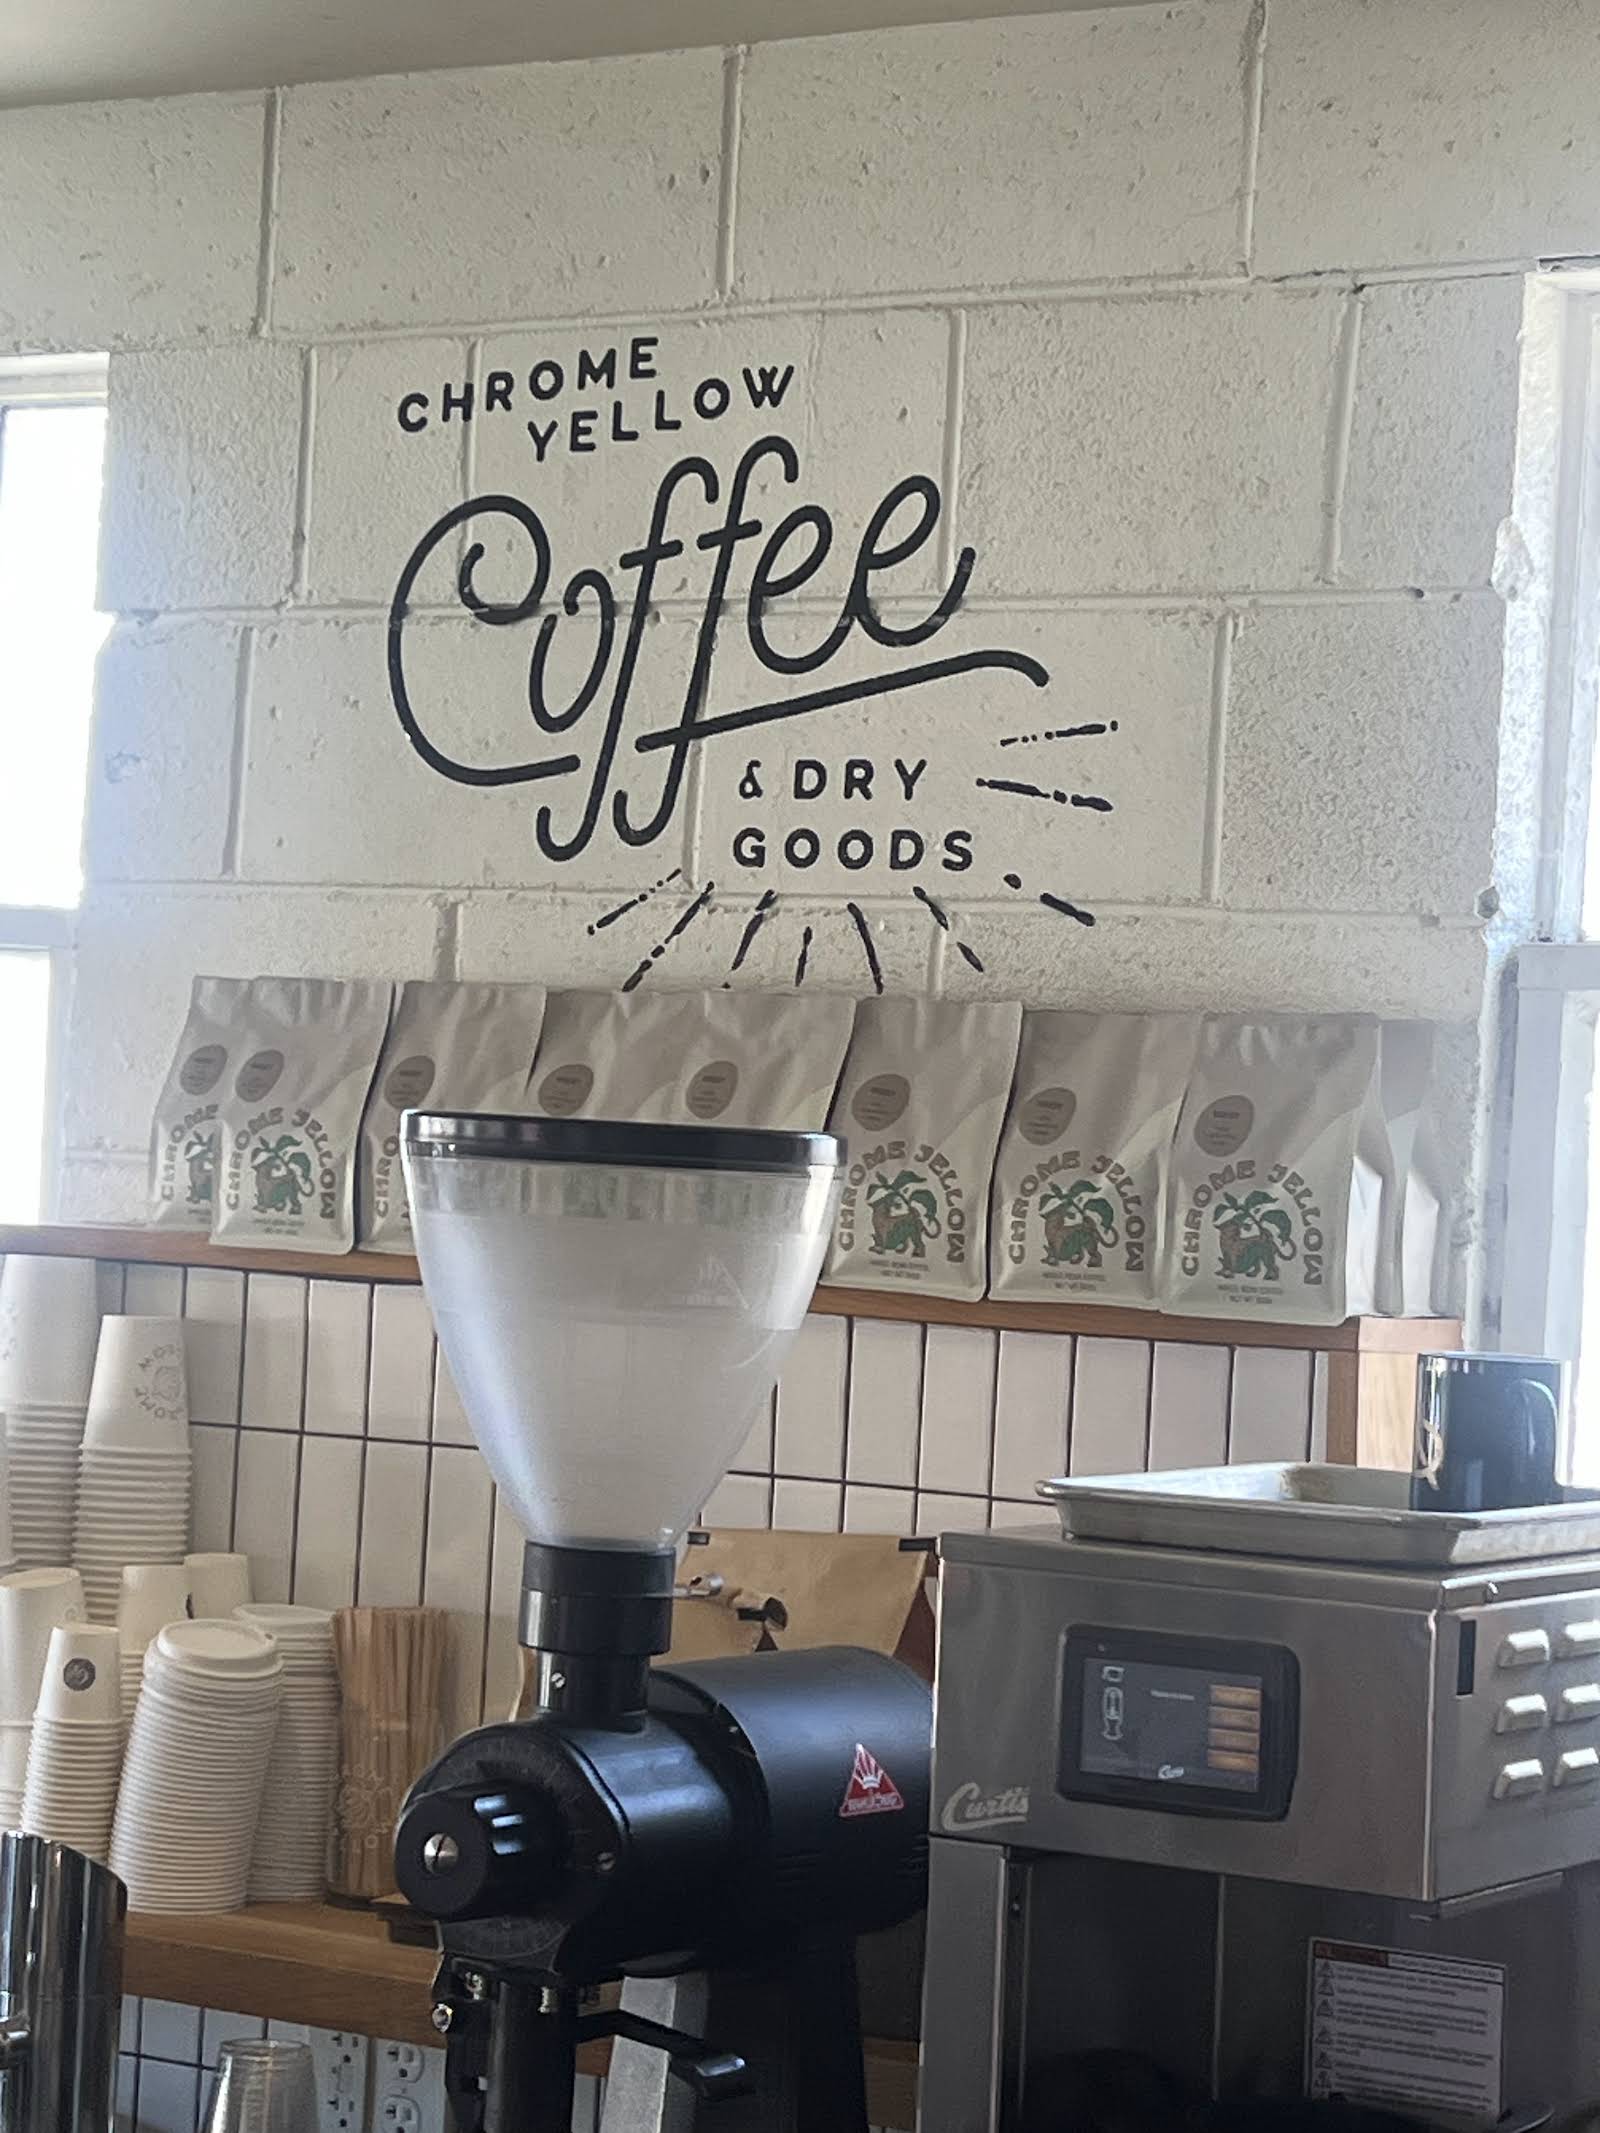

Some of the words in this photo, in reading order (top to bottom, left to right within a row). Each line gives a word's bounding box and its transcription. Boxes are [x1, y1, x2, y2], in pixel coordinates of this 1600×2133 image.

[397, 337, 659, 433] CHROME
[527, 365, 795, 462] YELLOW
[387, 435, 1049, 862] Coffee
[739, 760, 763, 800] &
[794, 759, 927, 801] DRY
[733, 827, 973, 872] GOODS
[226, 1107, 284, 1211] CHROME
[292, 1108, 337, 1219] YELLOW
[376, 1135, 400, 1218] CHRO
[839, 1141, 906, 1251] CHROME
[913, 1144, 966, 1264] YELLOW
[1008, 1151, 1080, 1264] CHROME
[1092, 1155, 1145, 1272] YELLOW
[1181, 1160, 1256, 1277] CHROME
[1268, 1163, 1323, 1286] YELLOW
